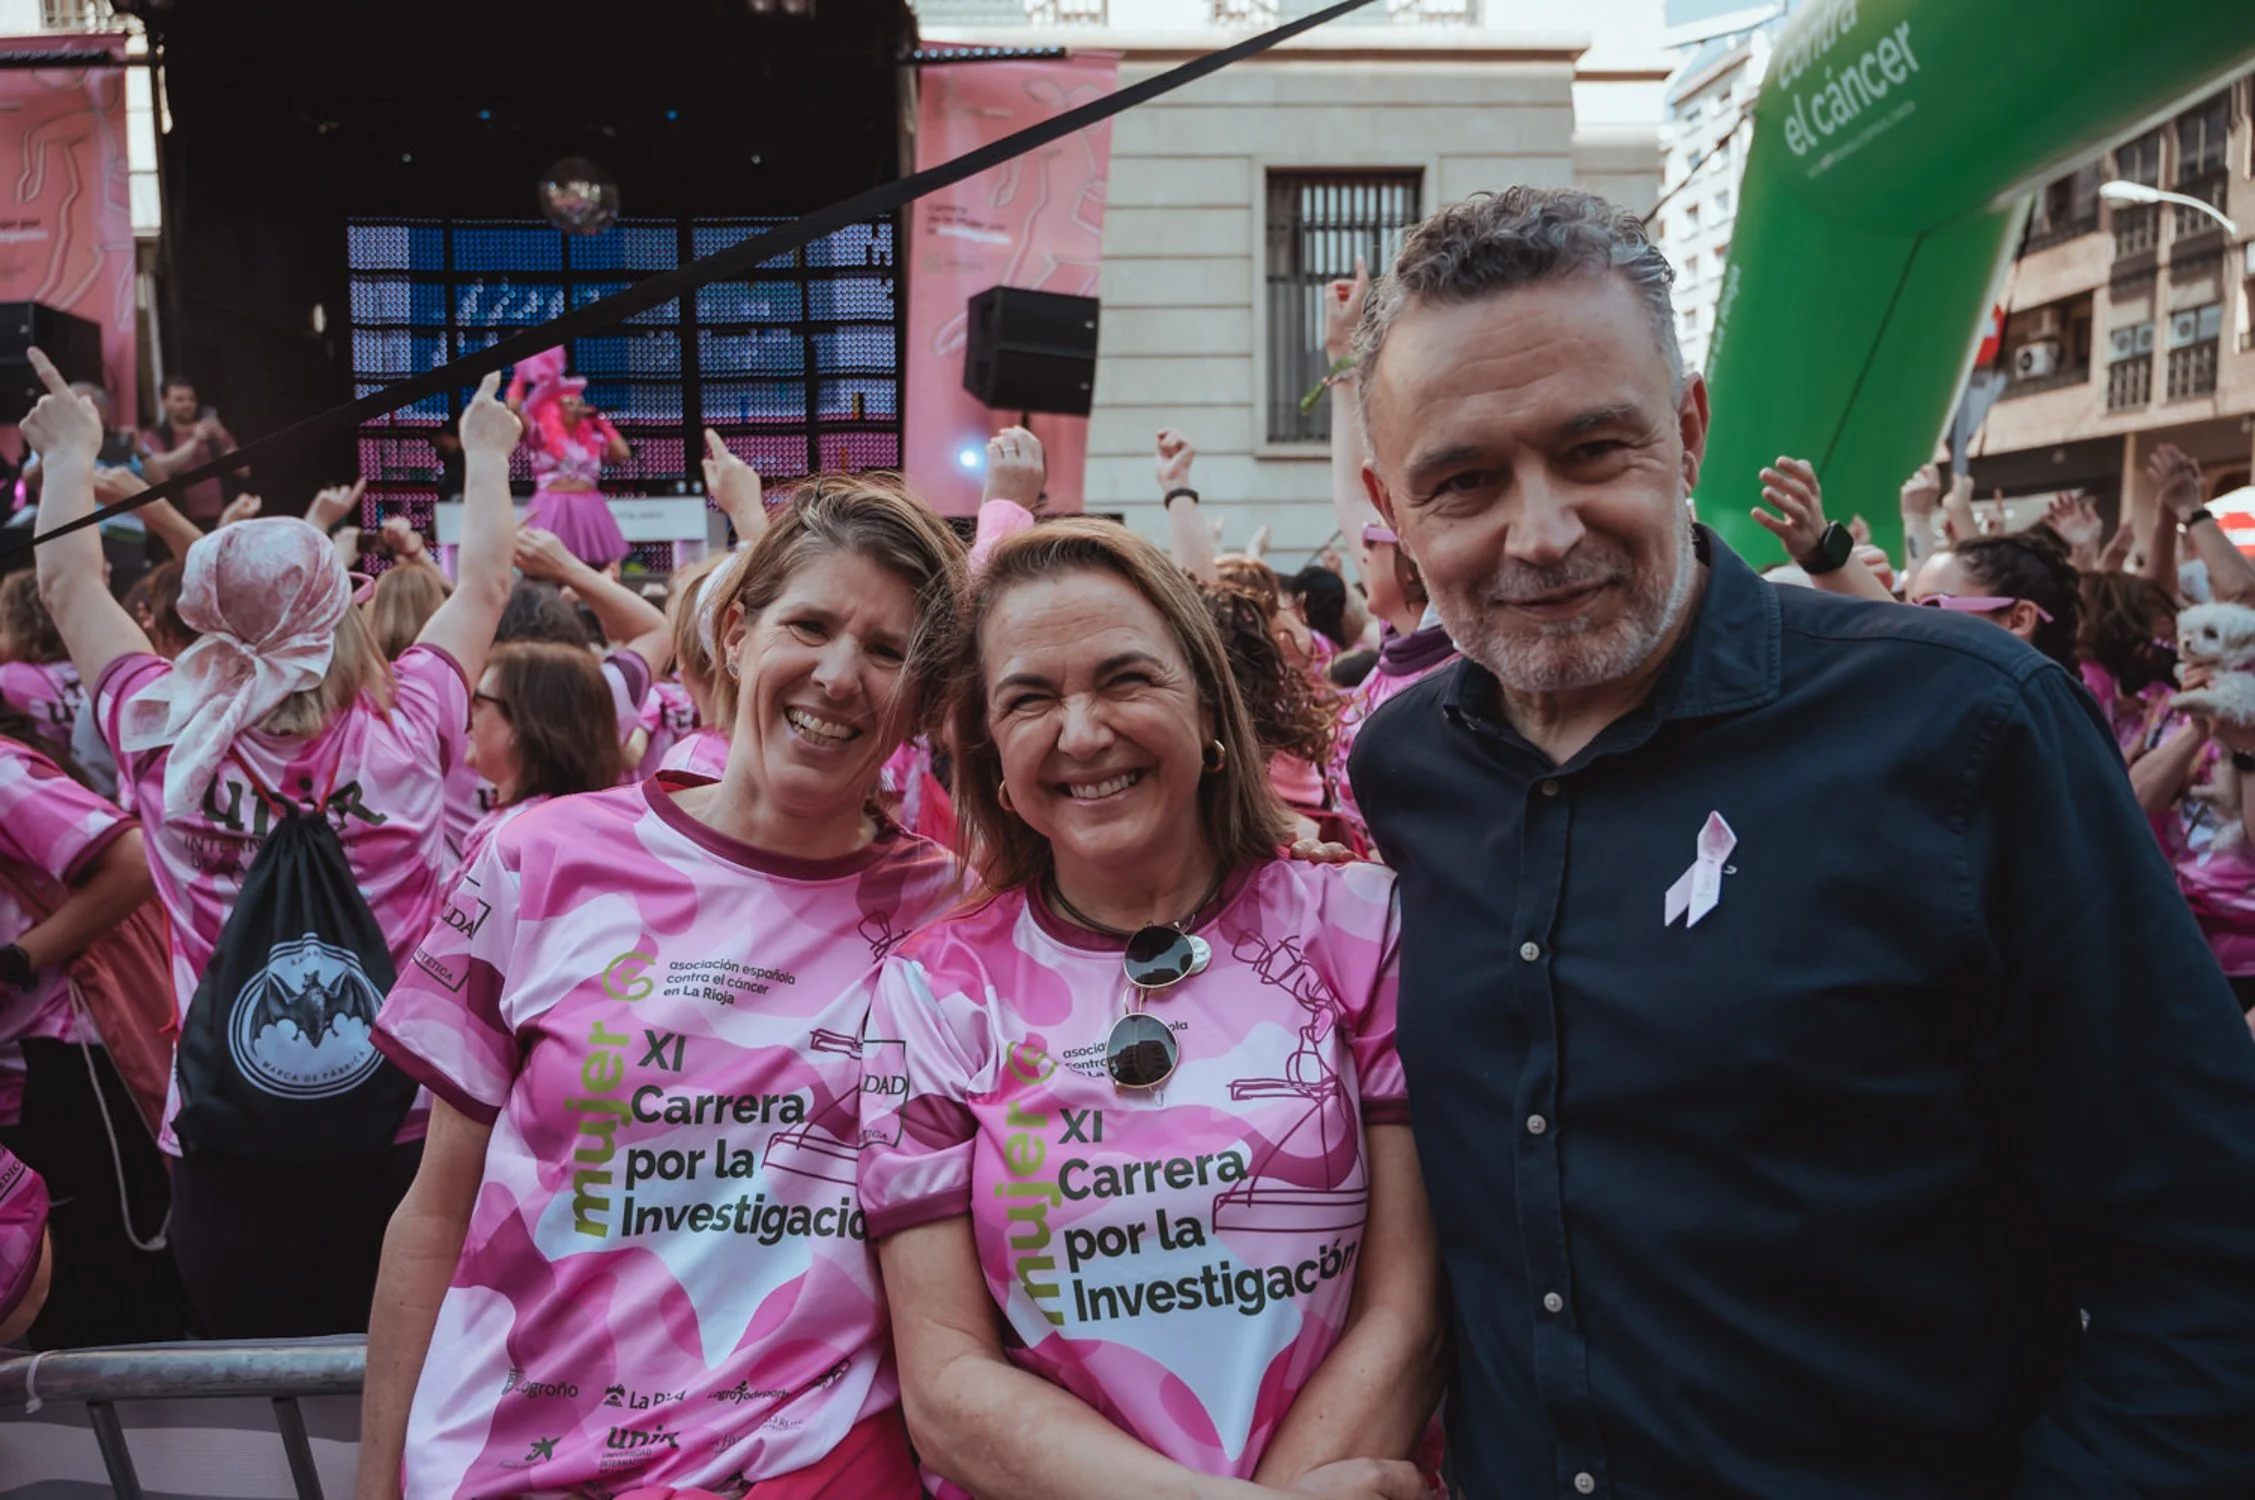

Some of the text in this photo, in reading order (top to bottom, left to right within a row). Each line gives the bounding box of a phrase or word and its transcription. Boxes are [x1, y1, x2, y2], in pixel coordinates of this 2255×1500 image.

[1784, 94, 1818, 157] el
[1811, 20, 1920, 135] cáncer
[666, 971, 769, 995] contra el cáncer
[669, 958, 797, 985] asociación española
[663, 985, 735, 1006] en La Rioja
[637, 1029, 687, 1073] XI
[631, 1084, 806, 1126] Carrera
[1058, 1107, 1103, 1145] XI
[565, 1020, 633, 1239] mujer
[625, 1139, 755, 1192] por la
[1057, 1149, 1249, 1202] Carrera
[1064, 1208, 1206, 1274] por la
[1072, 1239, 1358, 1325] Investigación
[629, 1391, 649, 1409] La
